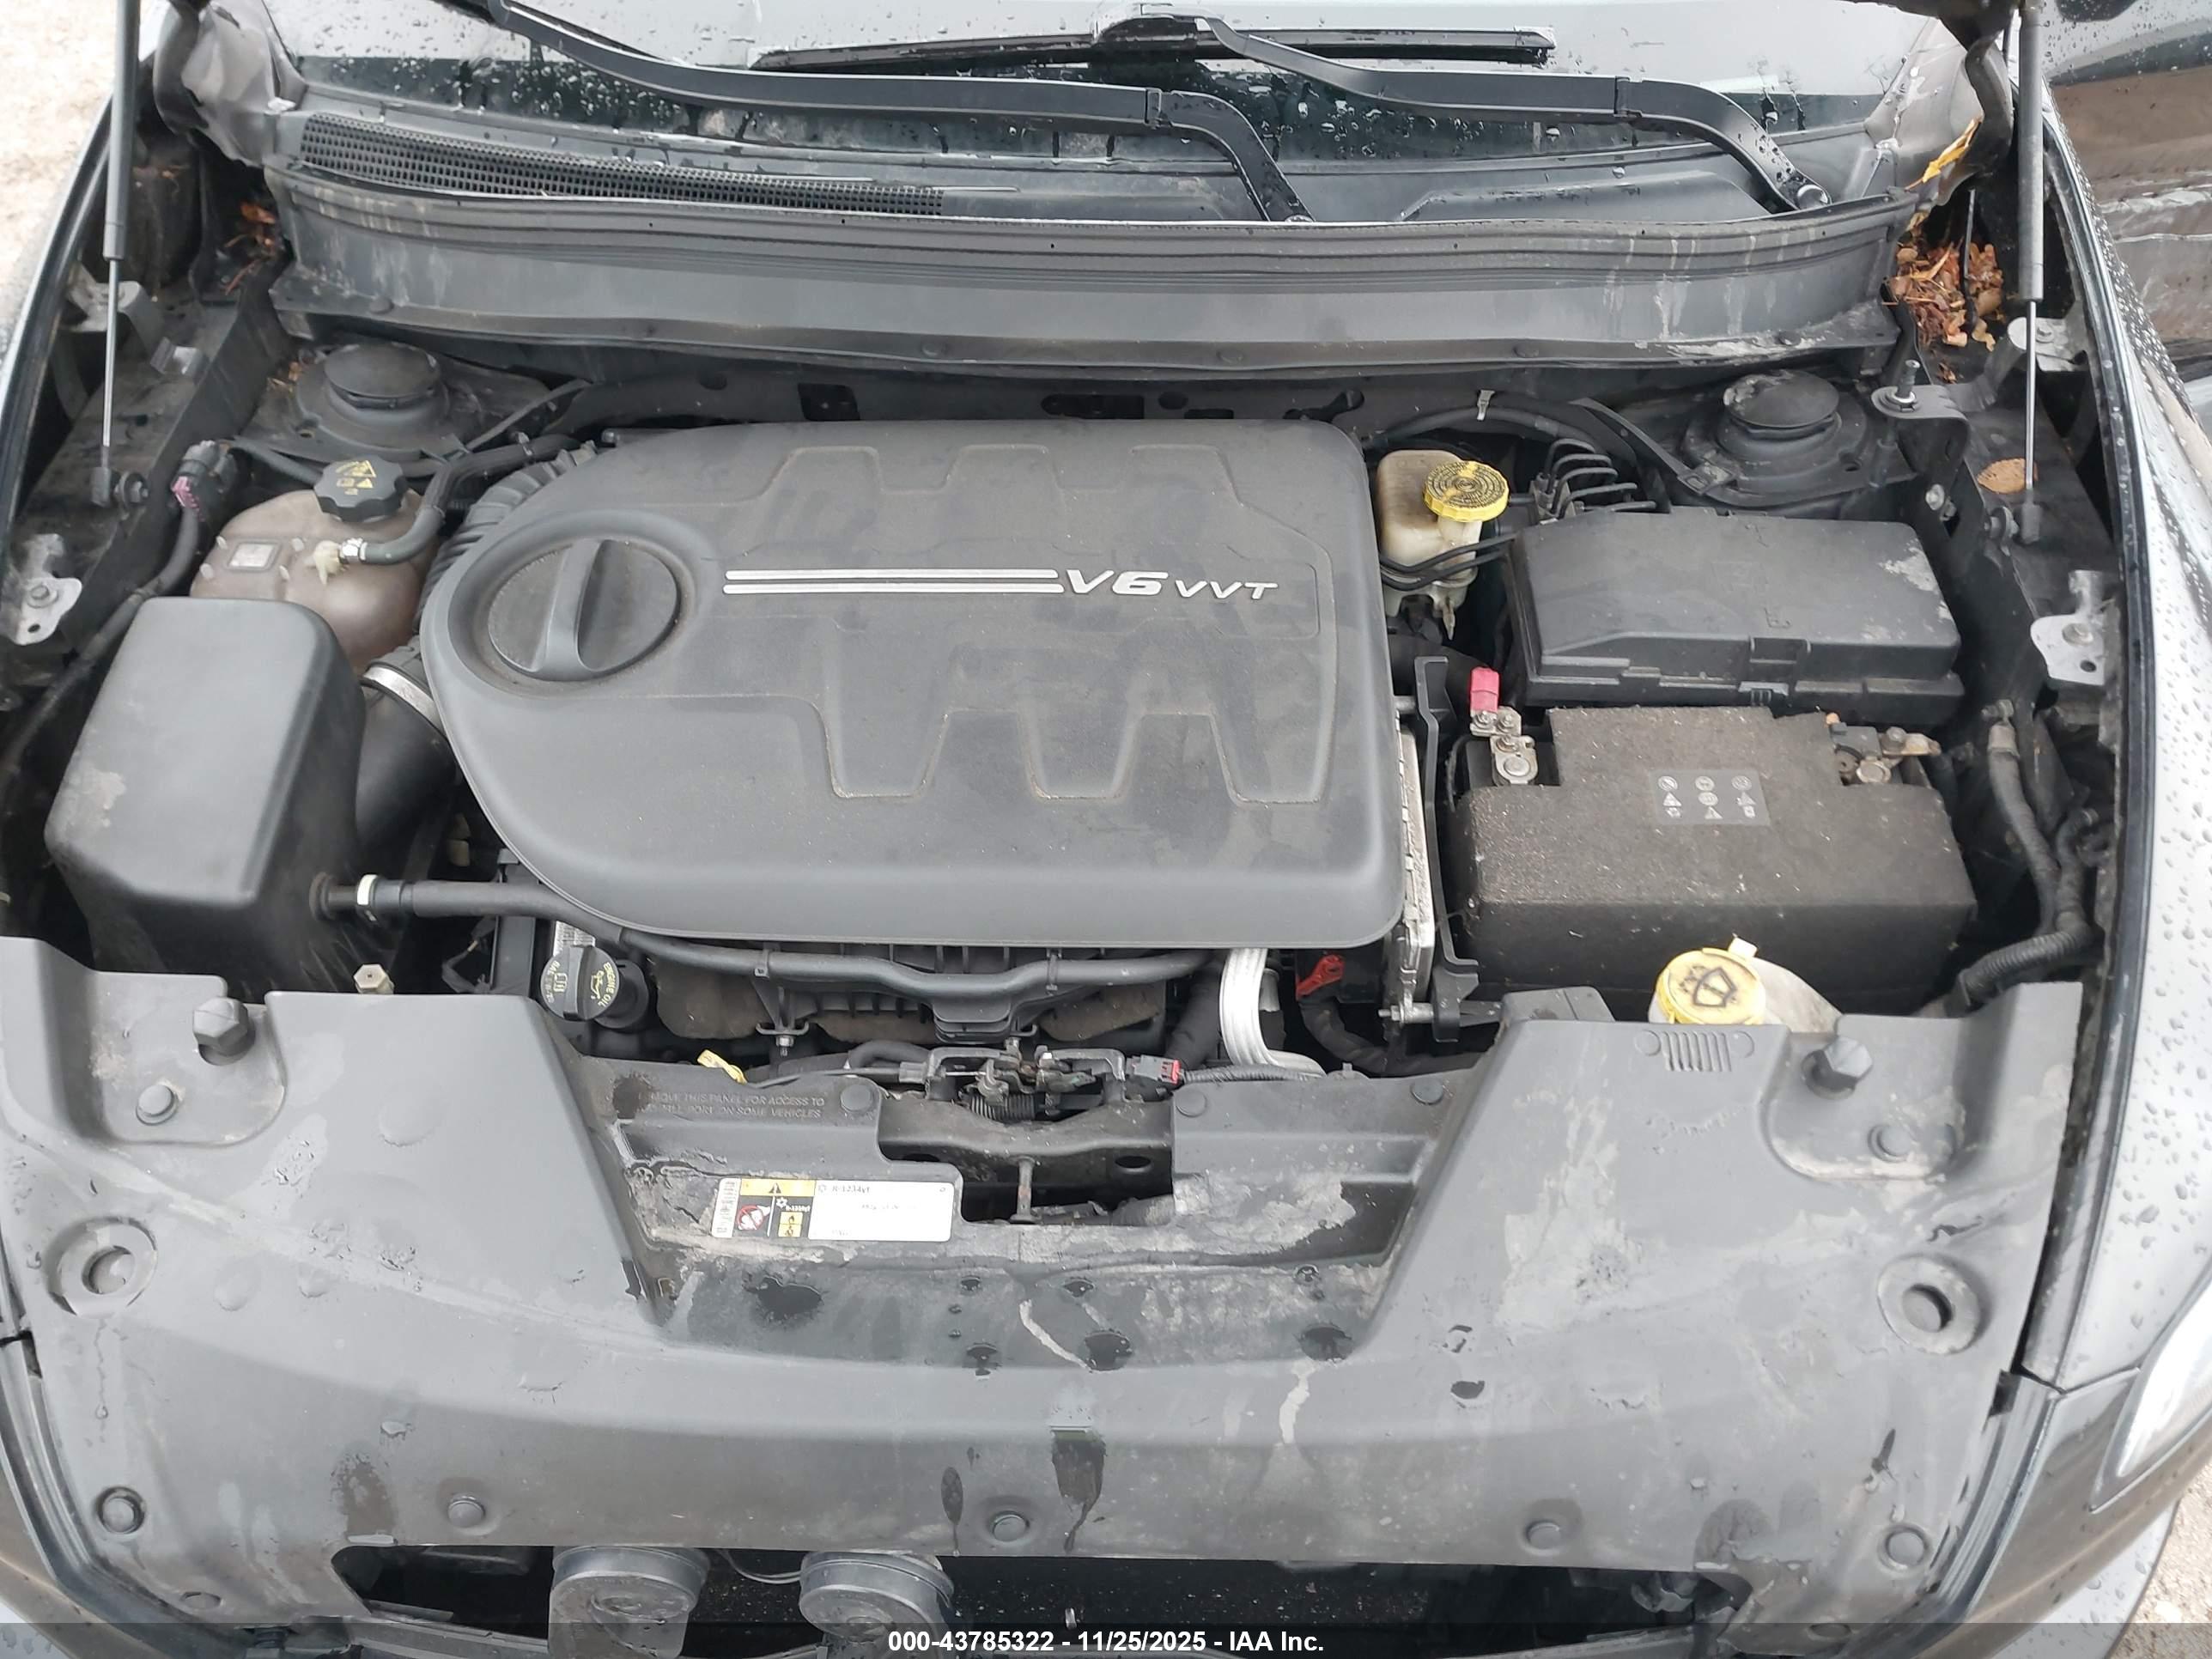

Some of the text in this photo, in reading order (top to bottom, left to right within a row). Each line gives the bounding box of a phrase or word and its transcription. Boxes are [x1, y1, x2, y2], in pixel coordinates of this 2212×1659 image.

[1066, 569, 1279, 599] V6 VVT
[598, 962, 616, 1007] ENGINE OIL
[811, 1097, 825, 1107] TO
